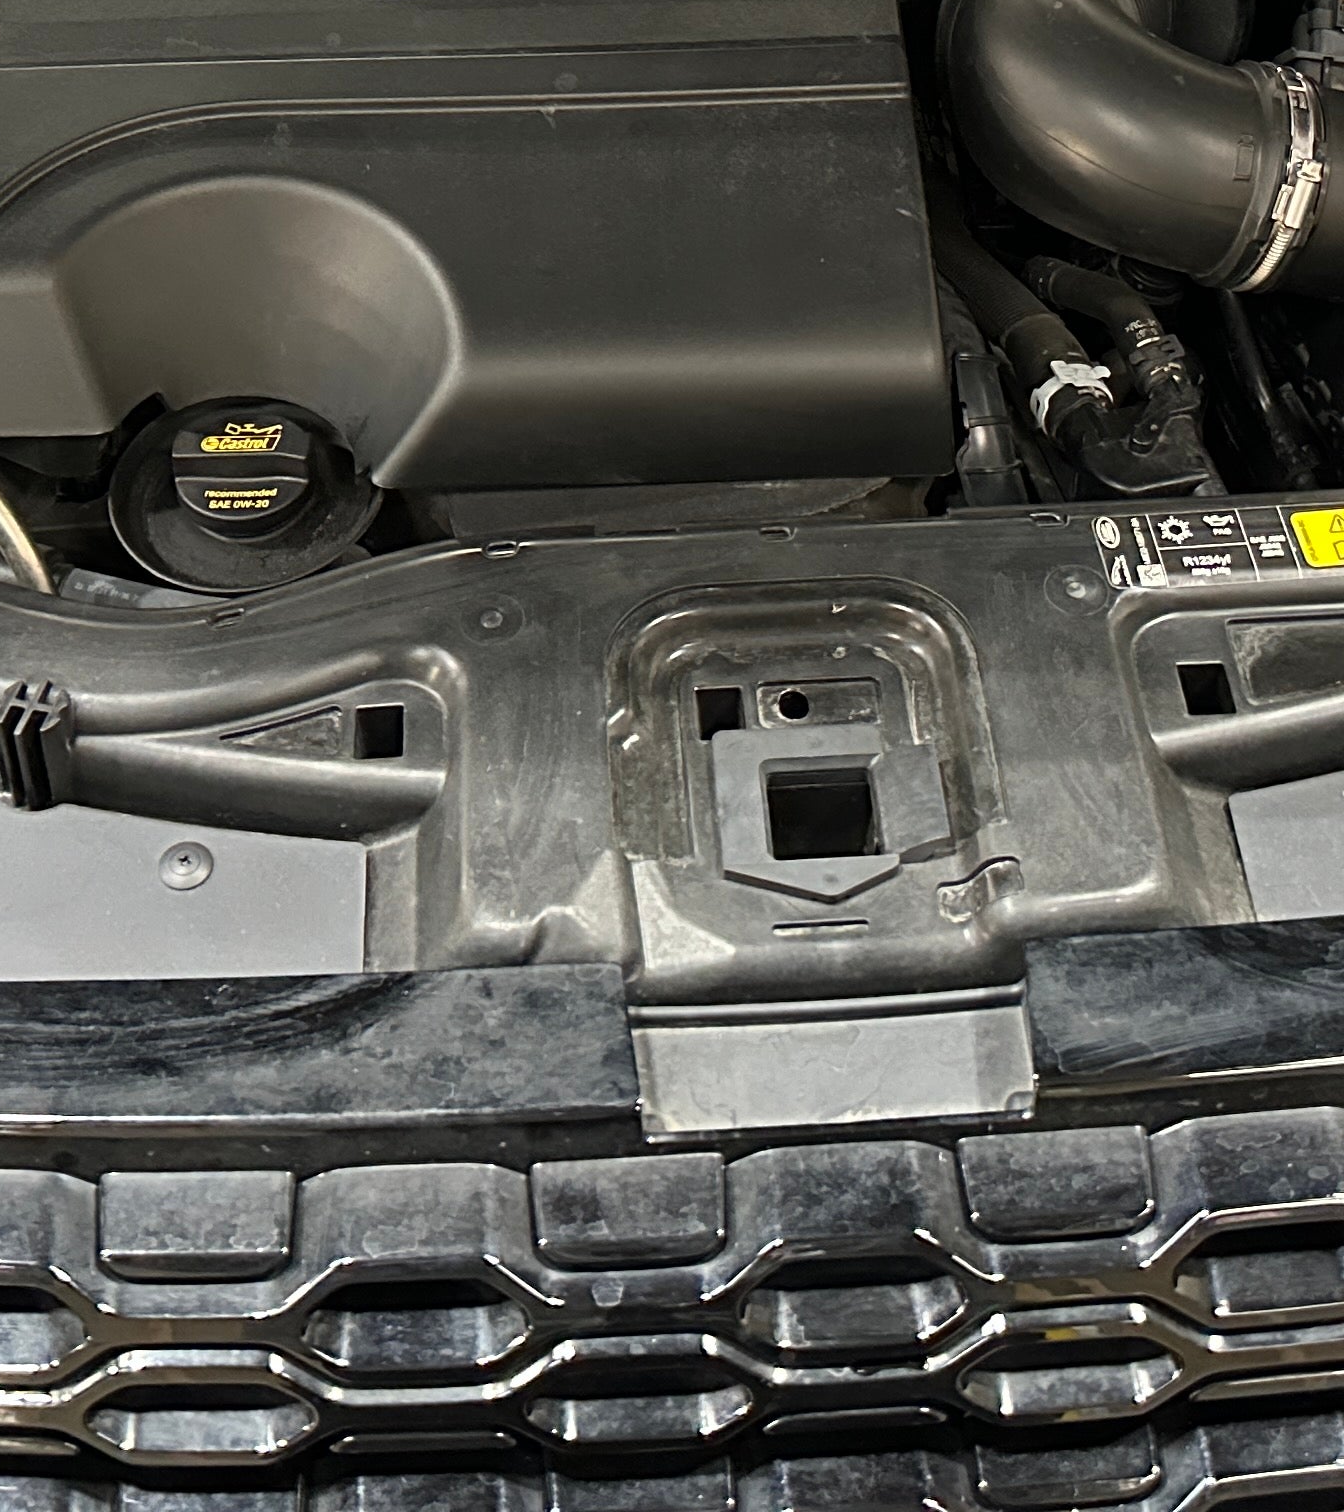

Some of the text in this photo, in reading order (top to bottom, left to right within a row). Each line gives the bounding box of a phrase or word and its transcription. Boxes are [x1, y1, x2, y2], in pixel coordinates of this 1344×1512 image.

[218, 438, 269, 449] Castrol
[204, 488, 277, 498] recommended
[208, 499, 270, 509] SAE 0W-20
